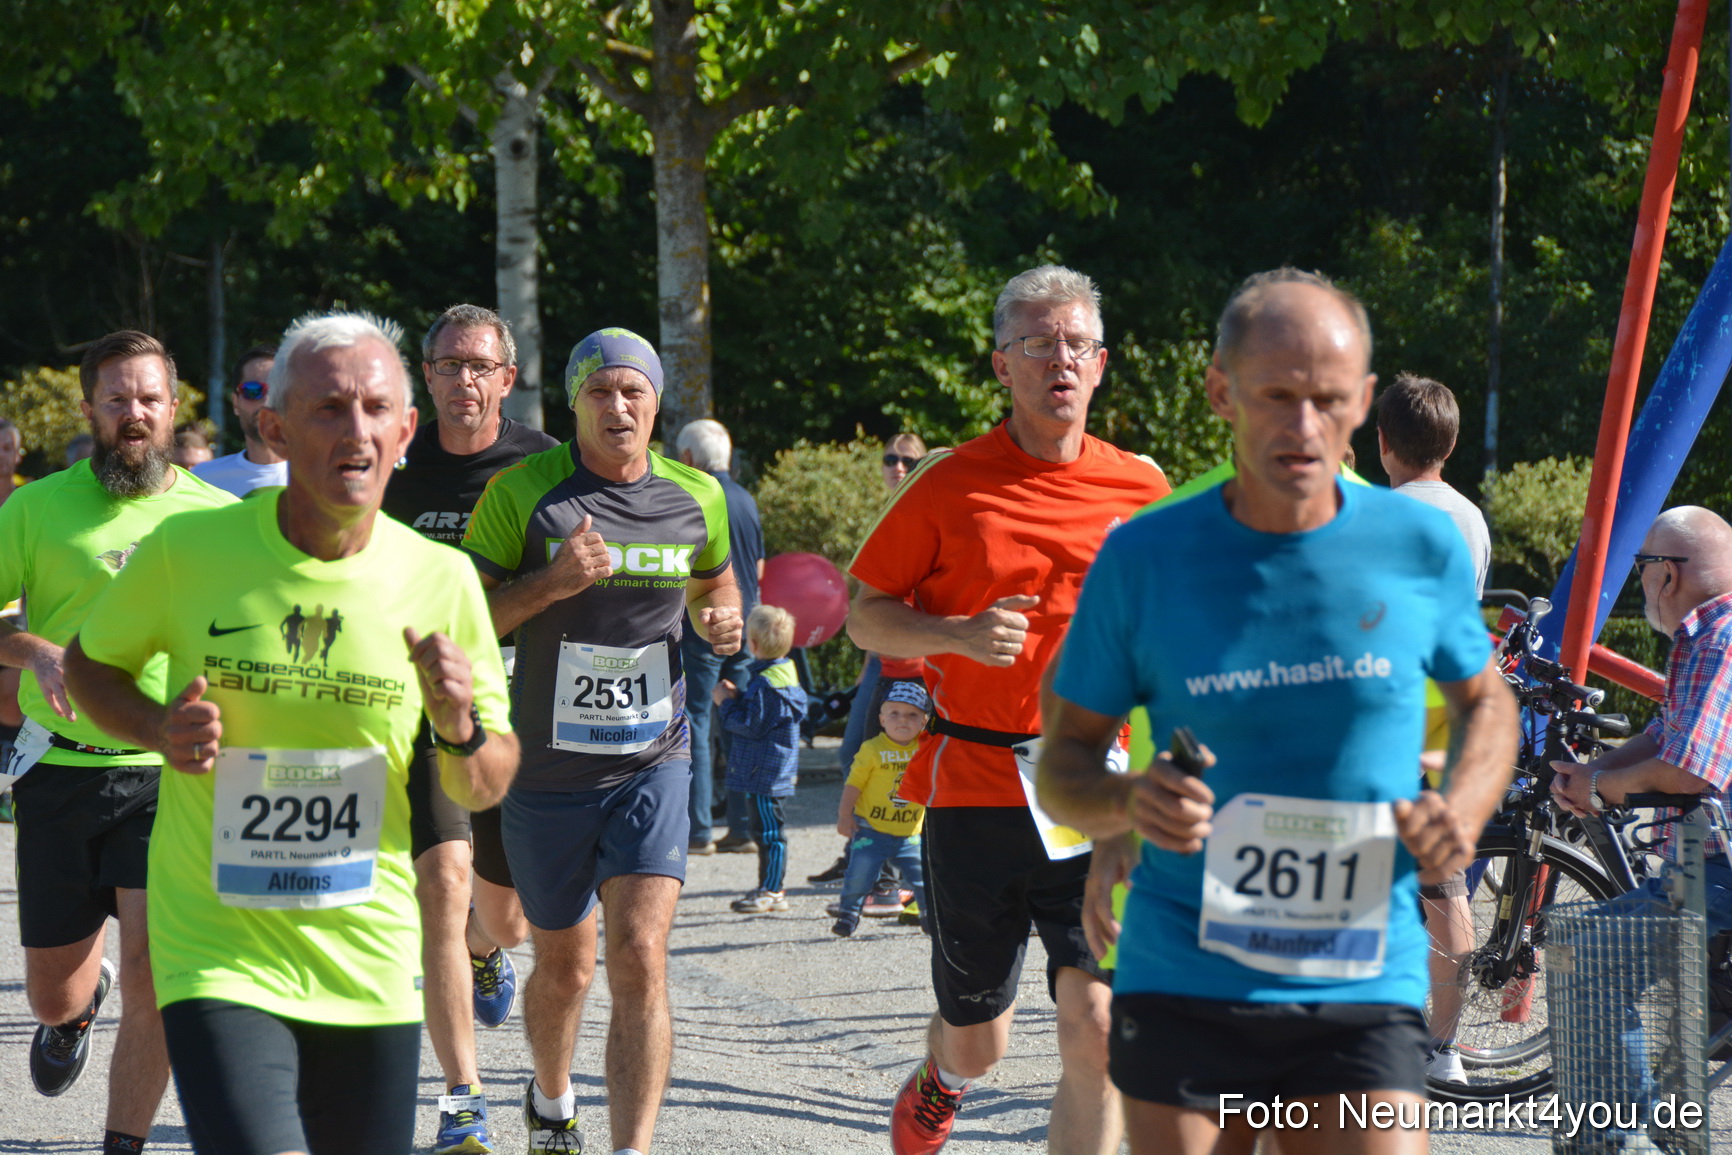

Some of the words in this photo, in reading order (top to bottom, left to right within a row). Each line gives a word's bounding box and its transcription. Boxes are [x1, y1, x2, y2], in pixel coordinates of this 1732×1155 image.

[613, 578, 650, 588] smart
[204, 655, 232, 670] SC
[593, 655, 639, 669] BOCK
[1185, 651, 1392, 696] www.hasit.de
[572, 673, 649, 710] 2531
[579, 713, 605, 721] PARTL
[606, 713, 639, 721] Neumarkt
[590, 728, 638, 743] Nicolai
[268, 765, 341, 781] BOCK
[240, 793, 361, 842] 2294
[870, 806, 919, 823] BLACK
[250, 850, 287, 860] PARTL
[289, 850, 337, 860] Neumarkt
[1234, 844, 1359, 901] 2611
[267, 872, 332, 891] Alfons
